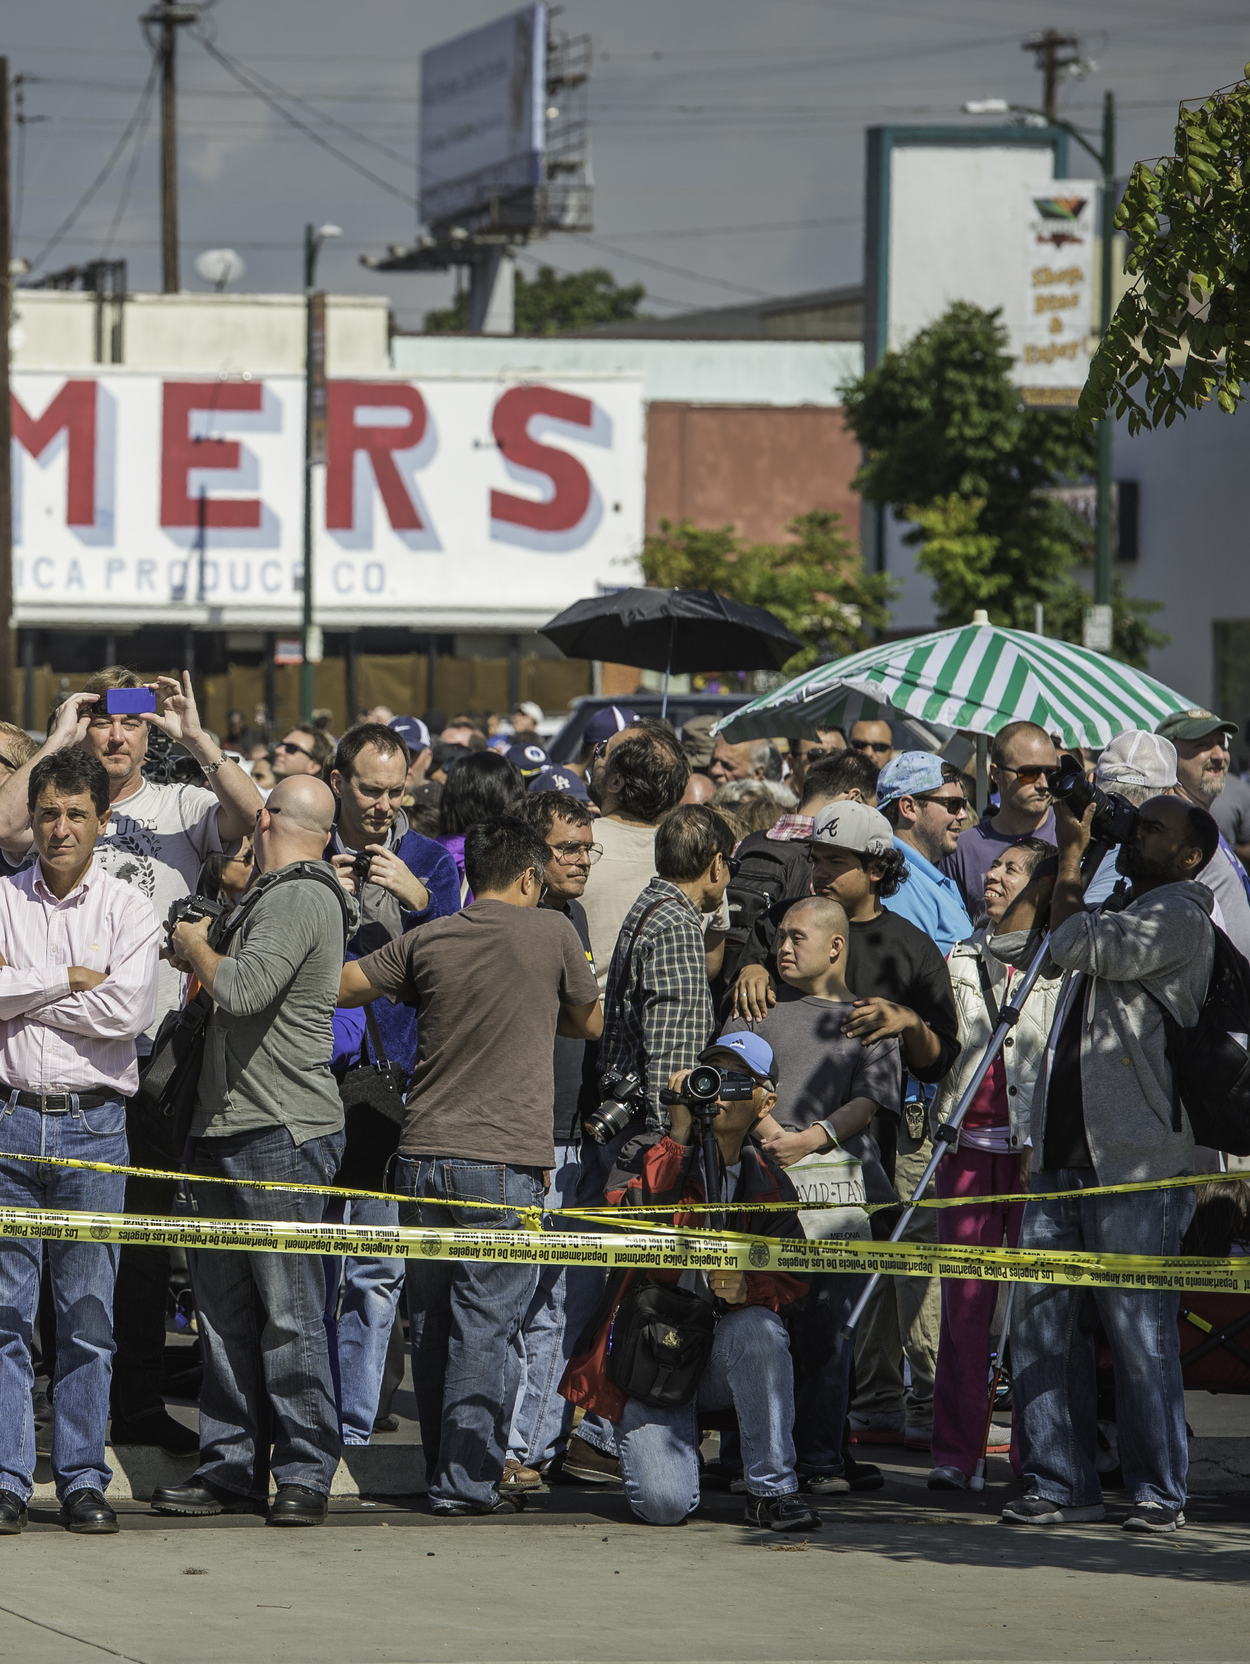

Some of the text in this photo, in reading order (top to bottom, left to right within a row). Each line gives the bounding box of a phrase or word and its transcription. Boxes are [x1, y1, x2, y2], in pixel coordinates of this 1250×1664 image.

[552, 774, 571, 790] LA
[3, 1225, 28, 1236] Police
[30, 1226, 63, 1238] Angeles
[64, 1228, 79, 1240] Los
[830, 1231, 860, 1239] MELONA
[118, 1230, 278, 1249] Departamento De Policia De Los Angeles
[284, 1239, 409, 1256] Los Angeles Police Department
[448, 1246, 608, 1263] Departamento De Policia De Los Angeles
[614, 1252, 738, 1268] Los Angeles Police Department
[777, 1257, 933, 1273] Departamento De Policia De Los Angeles
[938, 1263, 1054, 1282] Los Angeles Police Department
[1090, 1271, 1120, 1284] Angeles
[1121, 1273, 1134, 1285] Los
[1135, 1274, 1146, 1286] De
[1147, 1274, 1173, 1287] Policia
[1174, 1276, 1184, 1287] De
[1185, 1277, 1238, 1291] Departamento
